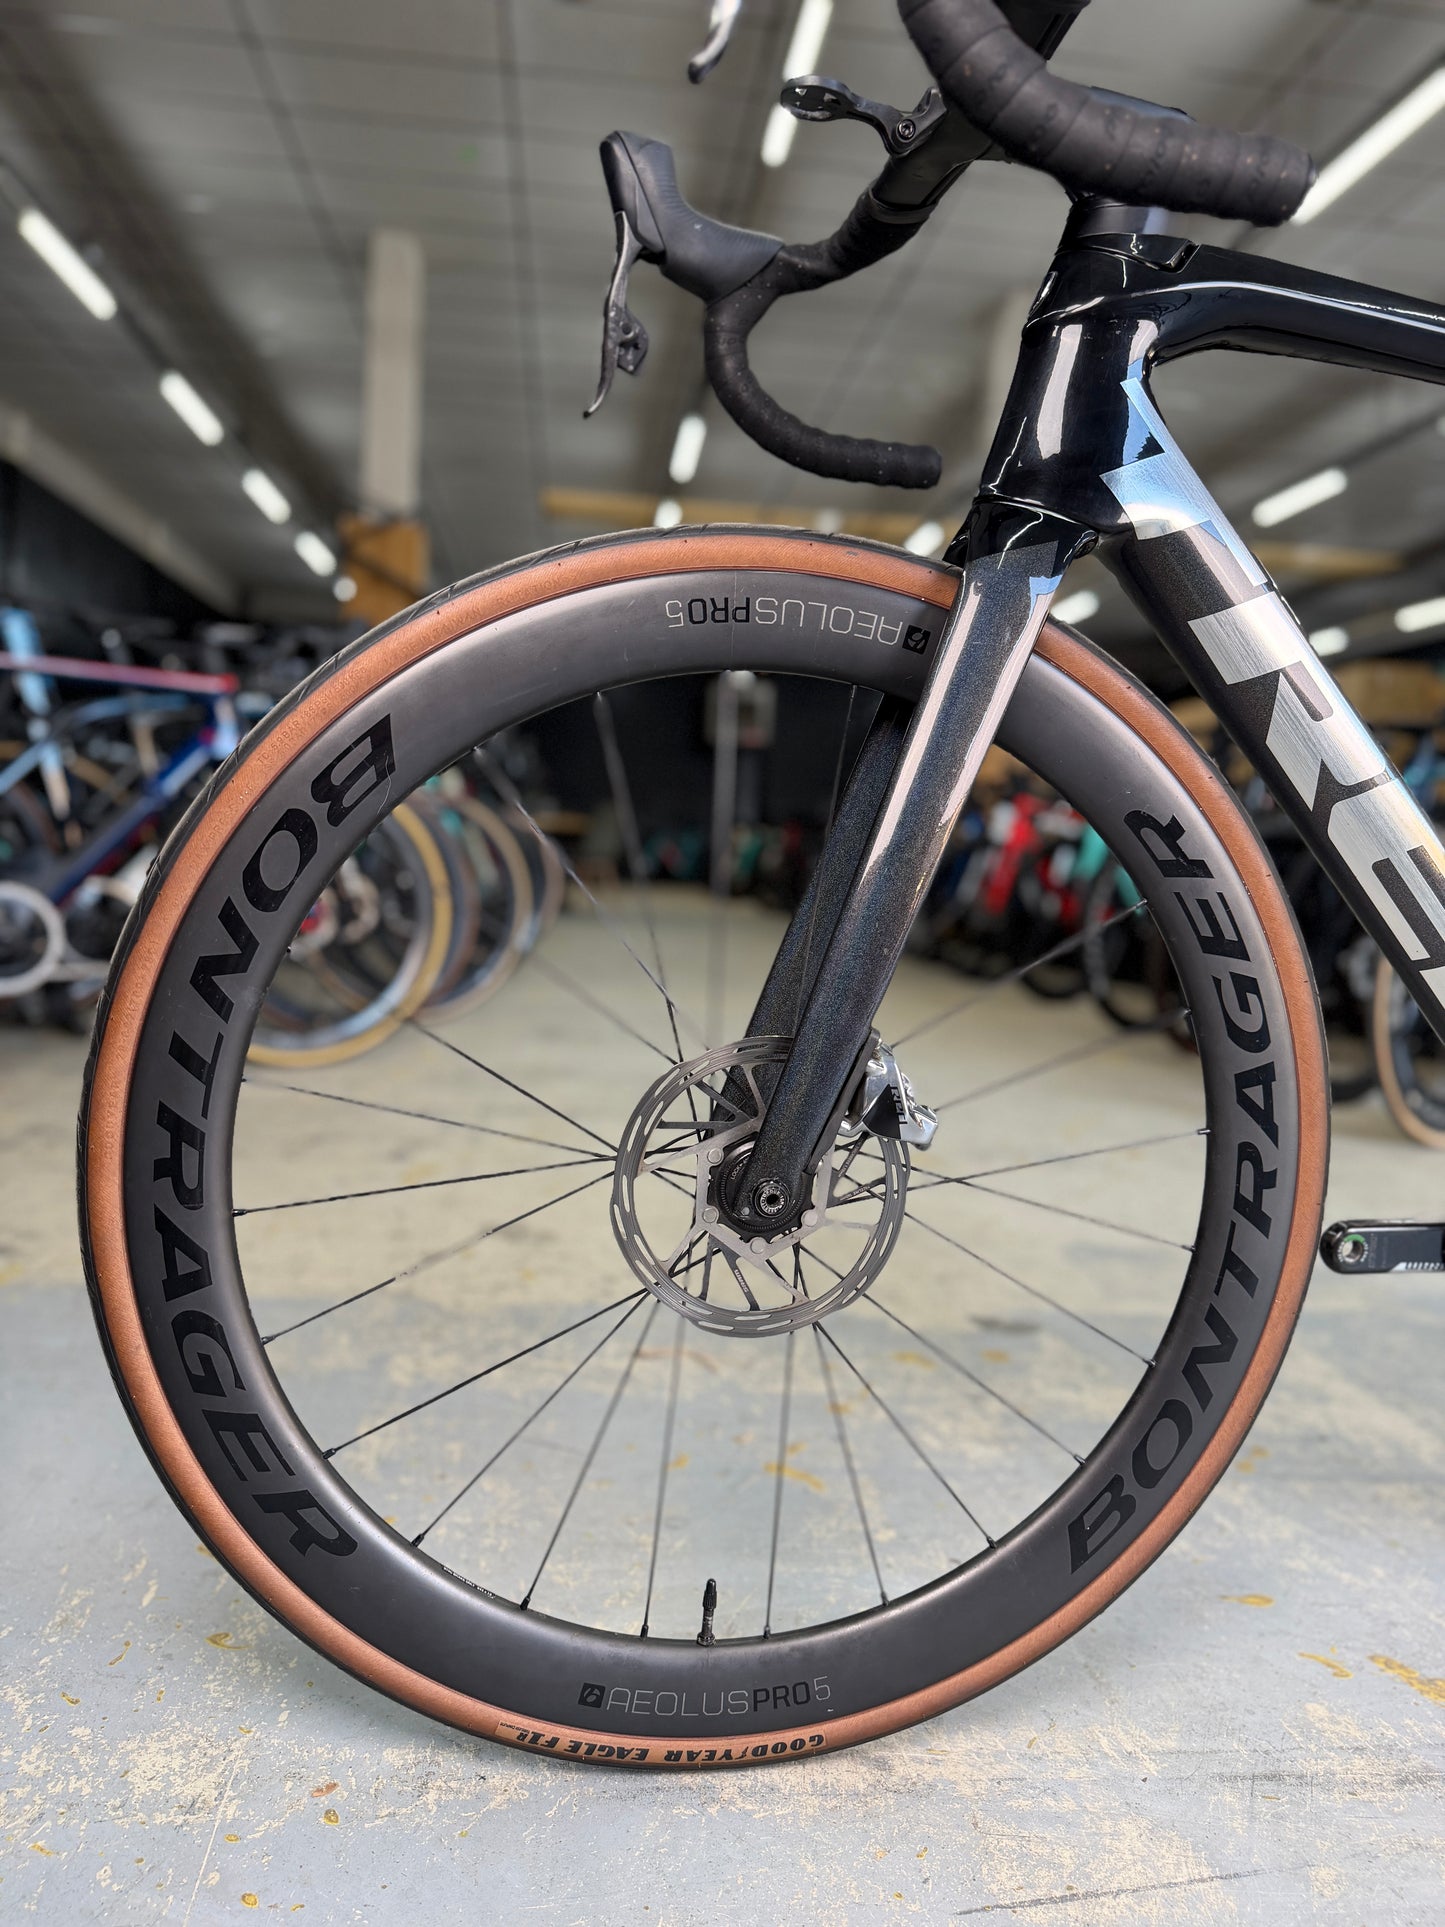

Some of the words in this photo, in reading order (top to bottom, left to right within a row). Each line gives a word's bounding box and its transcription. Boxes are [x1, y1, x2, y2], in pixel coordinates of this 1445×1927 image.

[1100, 378, 1445, 1016] TRE
[154, 713, 394, 1557] BONTRAGER
[1066, 808, 1280, 1575] BONTRAGER
[564, 1739, 650, 1761] EAGLE
[665, 1734, 825, 1762] GOODYEAR
